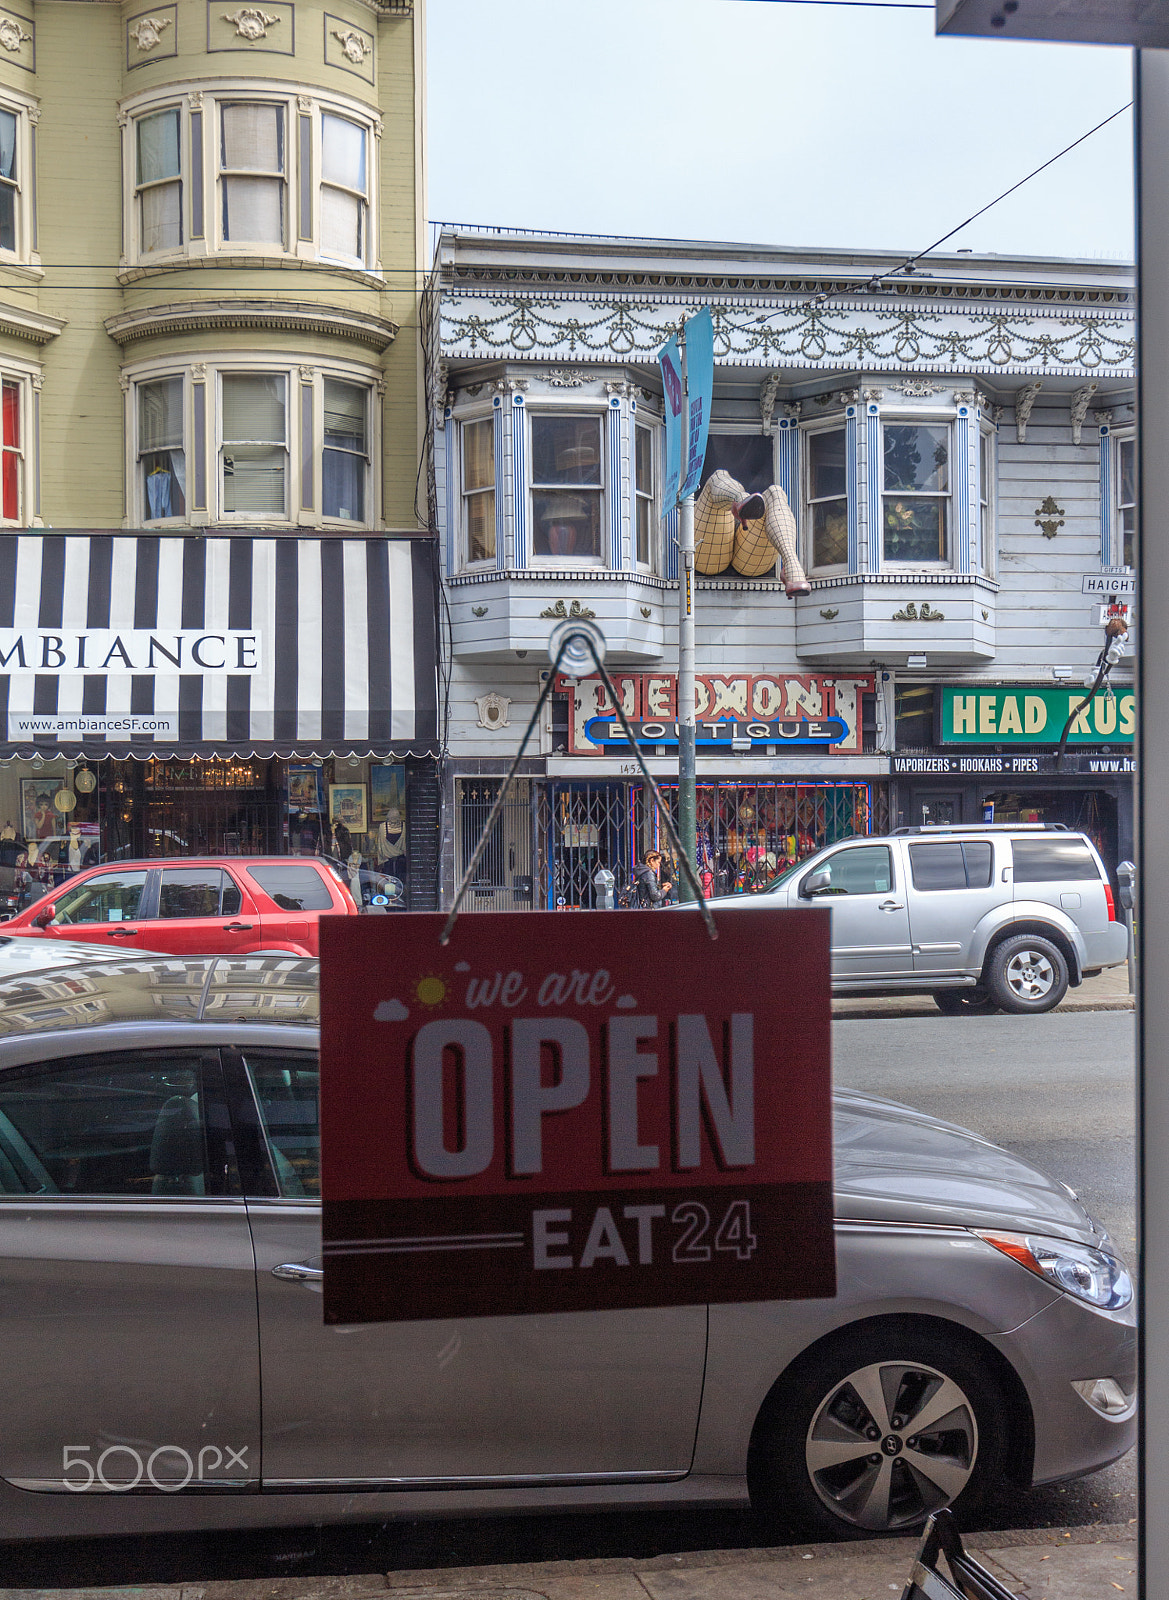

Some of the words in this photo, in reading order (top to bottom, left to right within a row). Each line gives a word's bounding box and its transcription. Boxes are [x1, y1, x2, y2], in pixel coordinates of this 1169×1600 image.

[1088, 579, 1137, 591] HAIGHT
[19, 719, 170, 731] www.ambianceSF.com
[953, 695, 1047, 734] HEAD
[1069, 695, 1136, 735] RUS
[895, 758, 950, 772] VAPORIZERS
[960, 758, 1003, 772] HOOKAHS
[1012, 758, 1038, 772] PIPES
[1089, 757, 1136, 772] www.he
[466, 971, 528, 1009] we
[538, 969, 616, 1007] are
[405, 1013, 756, 1183] OPEN
[532, 1201, 757, 1271] EAT24
